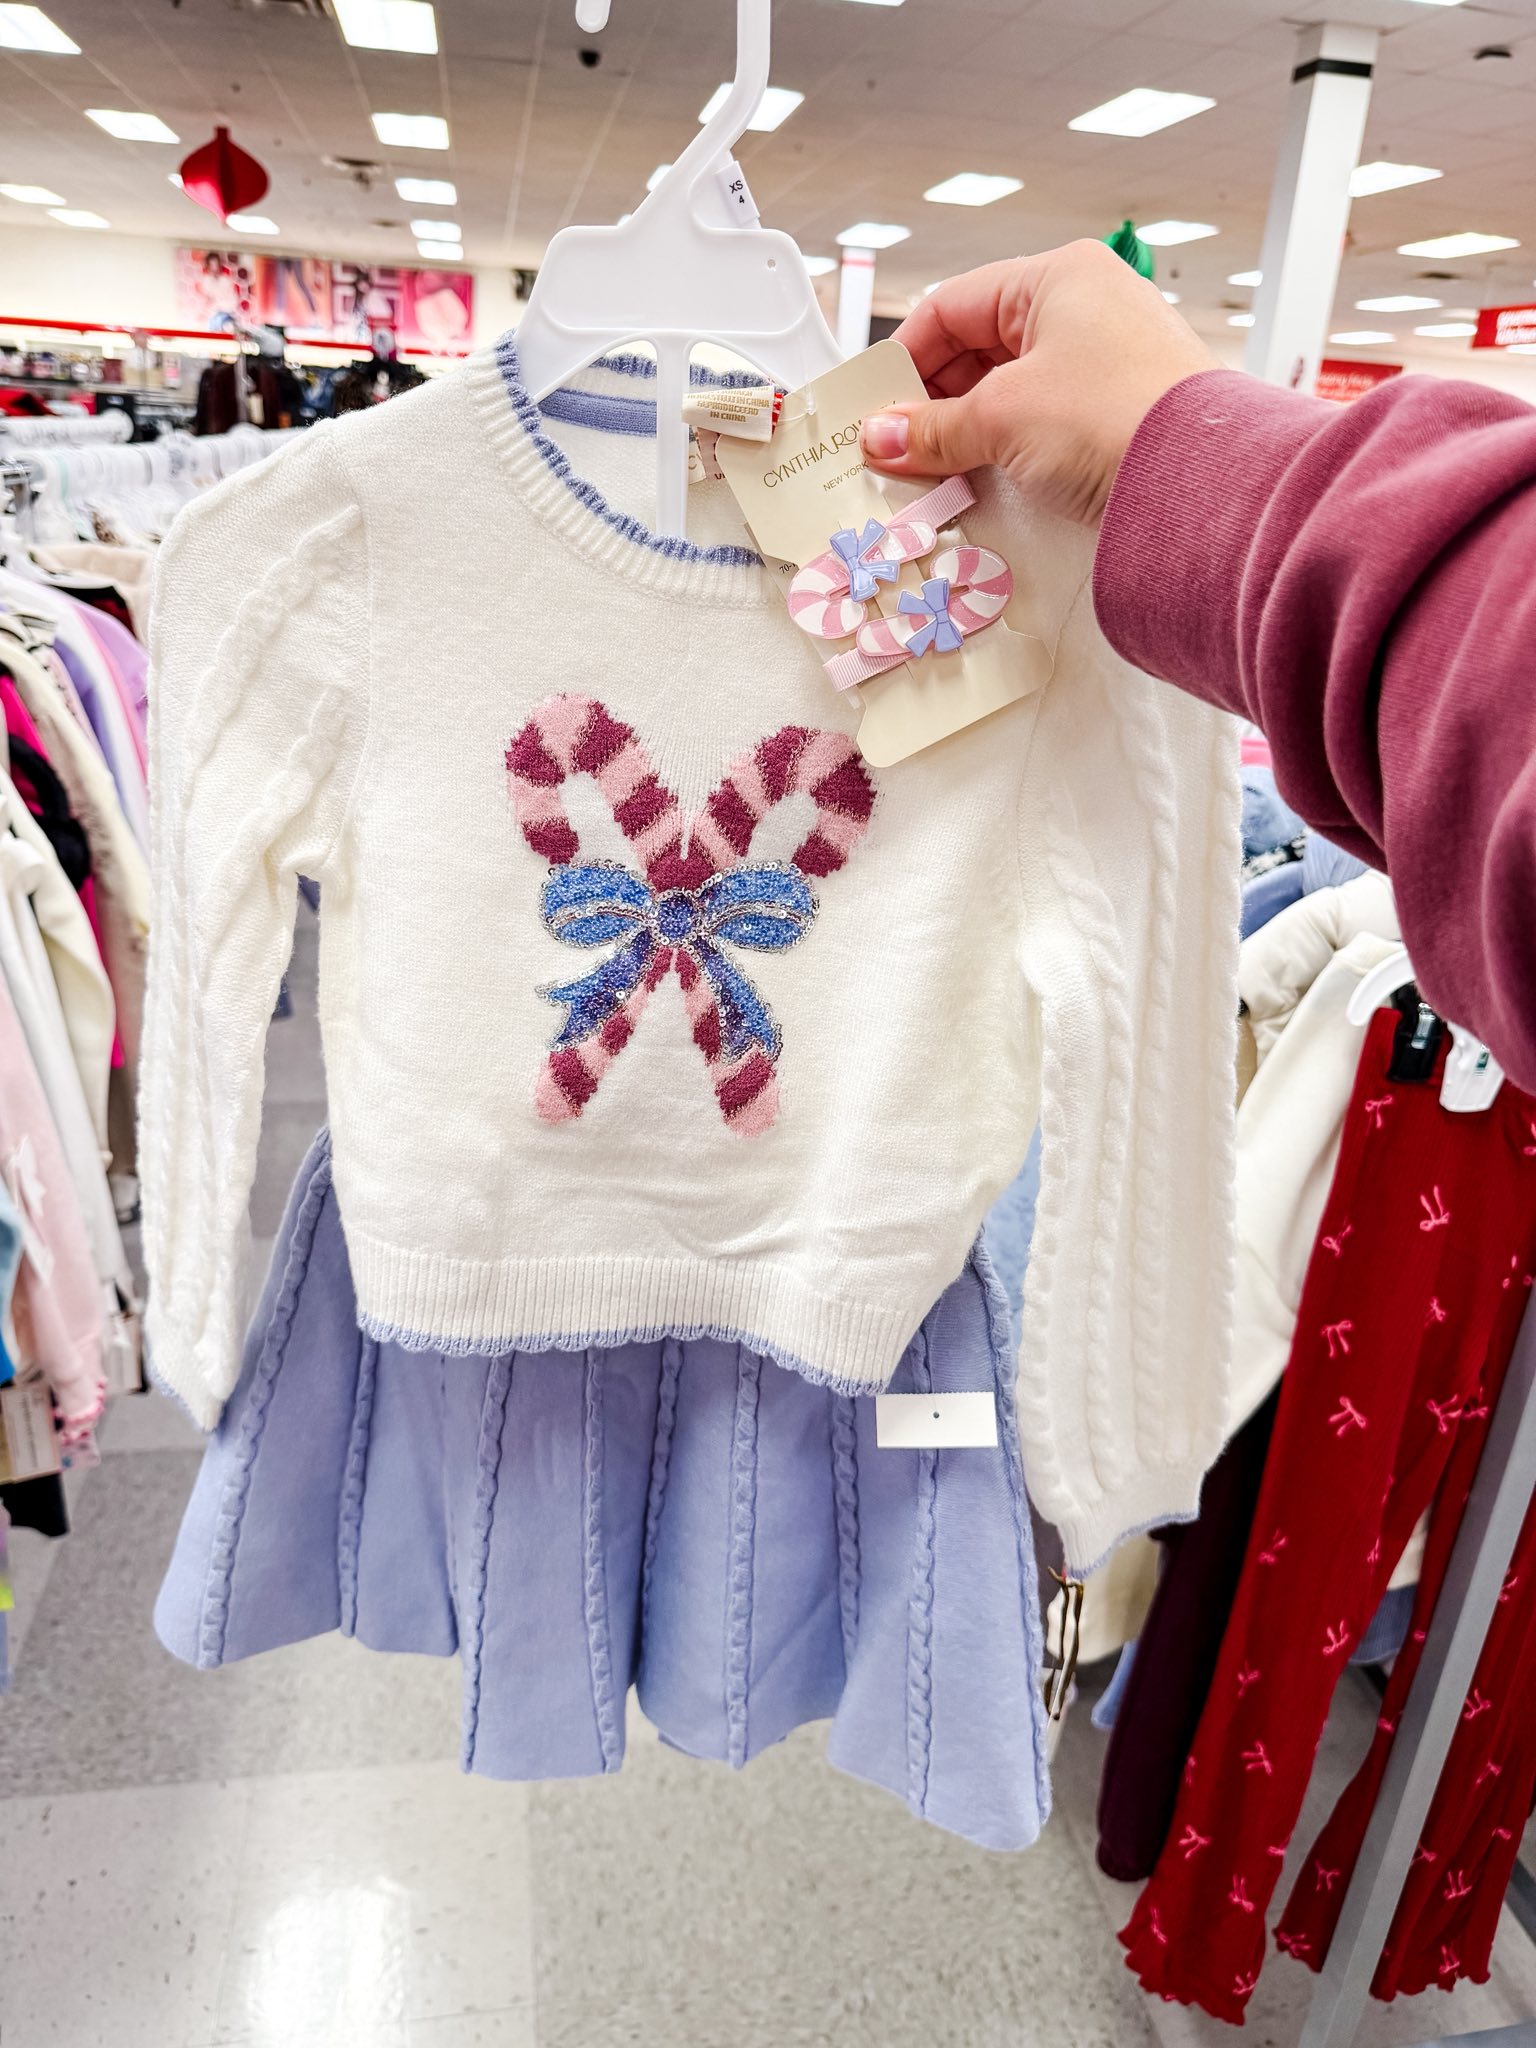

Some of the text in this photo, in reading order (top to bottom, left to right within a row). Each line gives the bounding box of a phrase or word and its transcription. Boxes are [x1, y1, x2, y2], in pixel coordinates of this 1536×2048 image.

[729, 180, 744, 194] XS
[738, 195, 745, 203] 4
[710, 411, 746, 422] IN CHINA
[763, 442, 836, 488] CYNTHIA
[823, 460, 869, 491] NEW YORK
